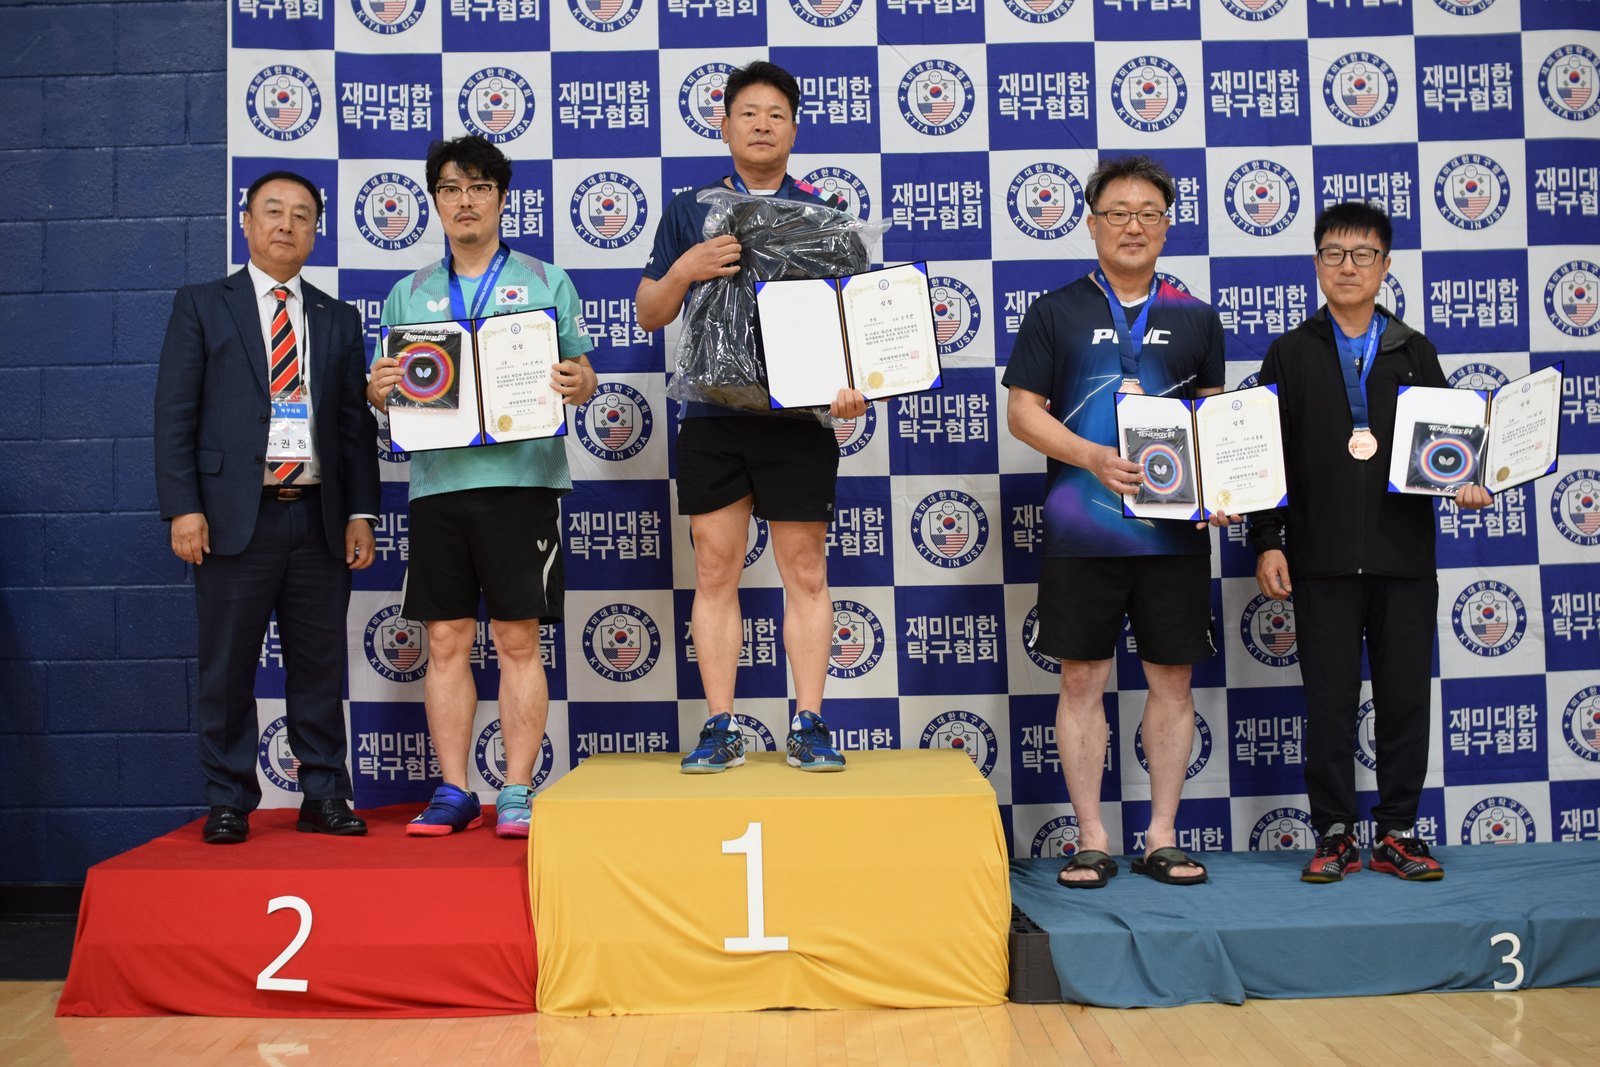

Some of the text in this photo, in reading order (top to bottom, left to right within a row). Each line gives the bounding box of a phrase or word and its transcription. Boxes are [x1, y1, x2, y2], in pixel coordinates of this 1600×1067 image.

[356, 10, 380, 33] KTTA
[403, 10, 421, 29] USA
[451, 0, 540, 21] 탁구협회
[573, 8, 597, 31] KTTA
[618, 7, 639, 27] USA
[792, 3, 859, 27] KTTA IN USA
[1037, 14, 1049, 22] IN
[1253, 12, 1264, 20] IN
[1541, 46, 1600, 75] 재미대한탁구협
[682, 64, 735, 93] 재미대한탁
[998, 72, 1089, 96] 재미대한
[1210, 69, 1300, 93] 재미대한
[1422, 63, 1513, 88] 재미대한
[342, 81, 433, 107] 재미대한
[558, 80, 650, 105] 재미대한
[797, 76, 871, 100] 미대한
[1424, 86, 1512, 112] 탁구협회
[560, 104, 649, 129] 탁구협회
[1000, 95, 1089, 121] 탁구협회
[1212, 93, 1299, 118] 탁구협회
[1329, 104, 1353, 125] KTTA
[1375, 104, 1394, 121] USA
[252, 116, 317, 140] KTTA IN USA
[343, 105, 432, 131] 탁구협회
[511, 120, 530, 137] USA
[684, 115, 710, 138] KTTA
[904, 112, 928, 133] KTTA
[951, 112, 970, 130] USA
[1117, 108, 1183, 131] KTTA IN USA
[1322, 171, 1412, 198] 재미대한
[1535, 167, 1599, 191] 재미대
[892, 181, 983, 206] 재미대한
[1536, 191, 1599, 215] 탁구협
[893, 205, 982, 231] 탁구협회
[1014, 216, 1080, 239] KTTA IN USA
[1231, 213, 1254, 234] KTTA
[1276, 213, 1295, 231] USA
[1441, 206, 1506, 229] KTTA IN USA
[361, 226, 424, 250] KTTA IN USA
[576, 225, 643, 248] KTTA IN USA
[1218, 284, 1308, 310] 재미대한
[1430, 278, 1519, 303] 재미대한
[1218, 309, 1307, 335] 탁구협회
[1432, 302, 1519, 328] 탁구협회
[1549, 312, 1589, 336] KTTA IN
[587, 323, 653, 348] 구협회
[957, 329, 976, 348] USA
[897, 394, 989, 419] 재미대한
[852, 432, 872, 452] USA
[899, 418, 989, 443] 탁구협회
[582, 436, 648, 460] KTTA IN USA
[569, 510, 661, 535] 재미대한
[1439, 511, 1527, 539] 탁구협회
[1556, 522, 1581, 544] KTTA
[570, 535, 661, 560] 탁구협회
[918, 544, 984, 567] KTTA IN USA
[906, 615, 998, 639] 재미대한
[908, 639, 998, 664] 탁구협회
[1247, 642, 1289, 665] KTTA IN
[1459, 632, 1523, 656] KTTA IN USA
[370, 657, 412, 681] KTTA IN
[589, 657, 656, 681] KTTA IN USA
[861, 654, 880, 673] USA
[1029, 649, 1055, 672] KTTA
[1235, 716, 1307, 742] 재미대
[1449, 704, 1538, 731] 재미대한
[576, 731, 669, 753] 재미대한
[1236, 741, 1306, 766] 탁구협
[1451, 728, 1537, 756] 탁구협회
[1567, 738, 1592, 760] KTTA
[265, 767, 289, 789] KTTA
[1188, 756, 1207, 776] USA
[721, 822, 789, 951] 1
[256, 895, 313, 992] 2
[1489, 932, 1524, 991] 3
